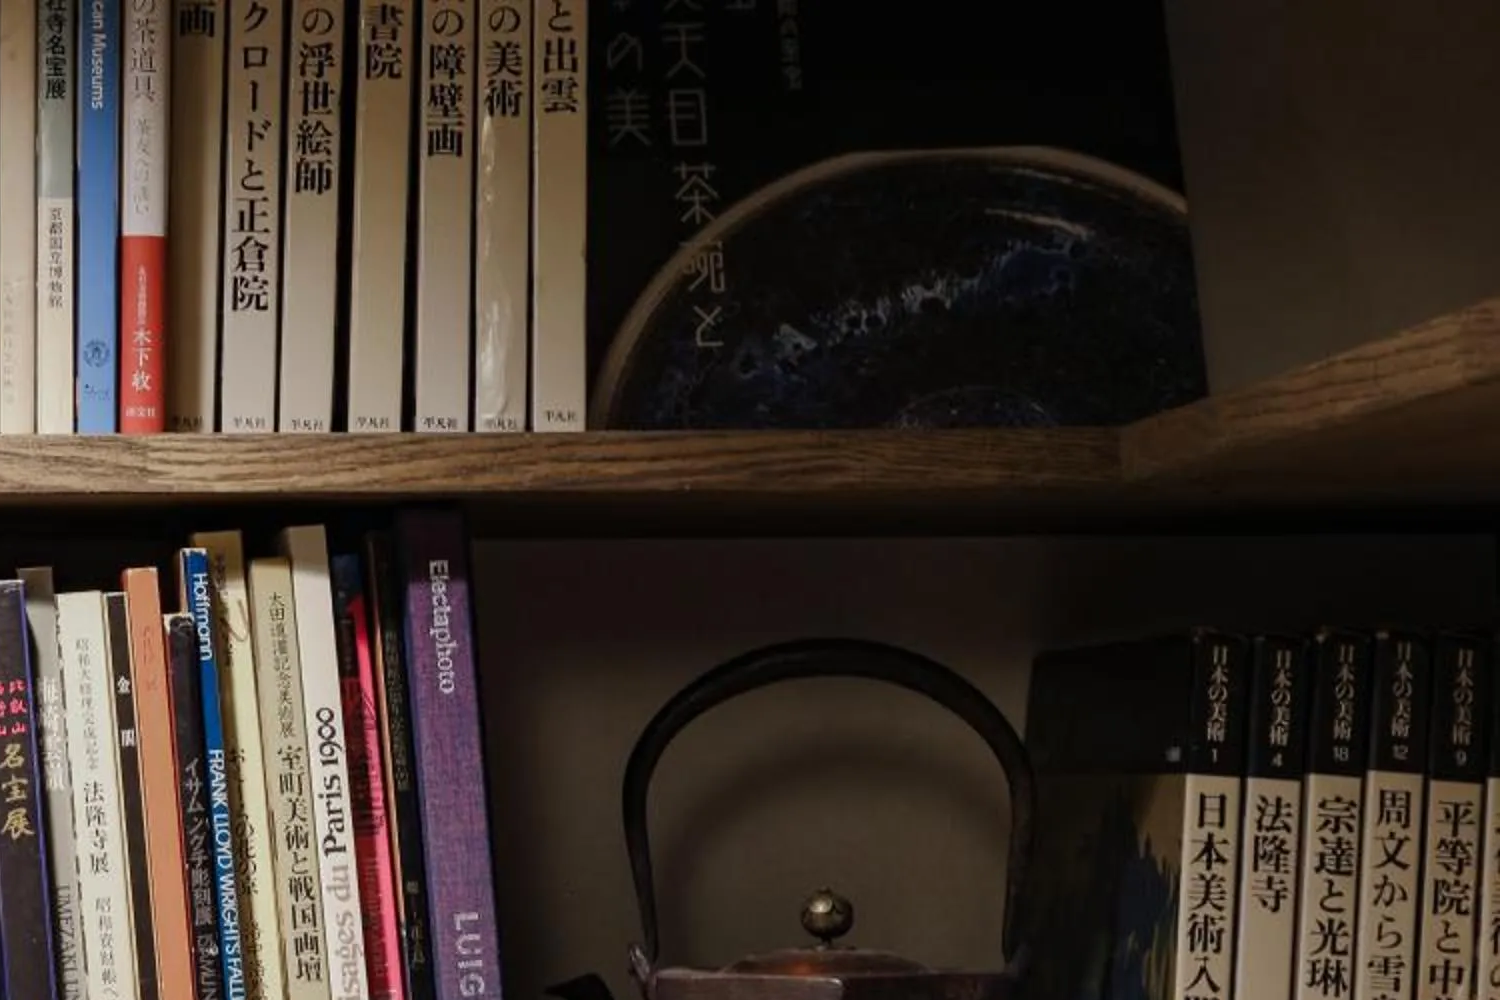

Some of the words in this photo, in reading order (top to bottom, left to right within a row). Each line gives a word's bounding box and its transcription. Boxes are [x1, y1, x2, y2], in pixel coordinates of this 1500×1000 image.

[91, 34, 107, 110] Museums
[295, 6, 337, 196] の浮世絵師
[427, 8, 467, 158] の障壁画
[483, 8, 525, 119] の美術
[542, 3, 579, 114] と出雲
[231, 2, 273, 313] クロードと正倉院
[660, 0, 728, 348] 天目茶碗と
[191, 572, 214, 662] Hoffmann
[207, 748, 229, 808] FRANK
[316, 706, 343, 767] 1900
[213, 813, 233, 869] LLOYD
[318, 771, 347, 858] Paris
[1251, 794, 1292, 914] 法隆寺
[325, 863, 352, 903] du
[1305, 796, 1358, 999] 宗達と光琳
